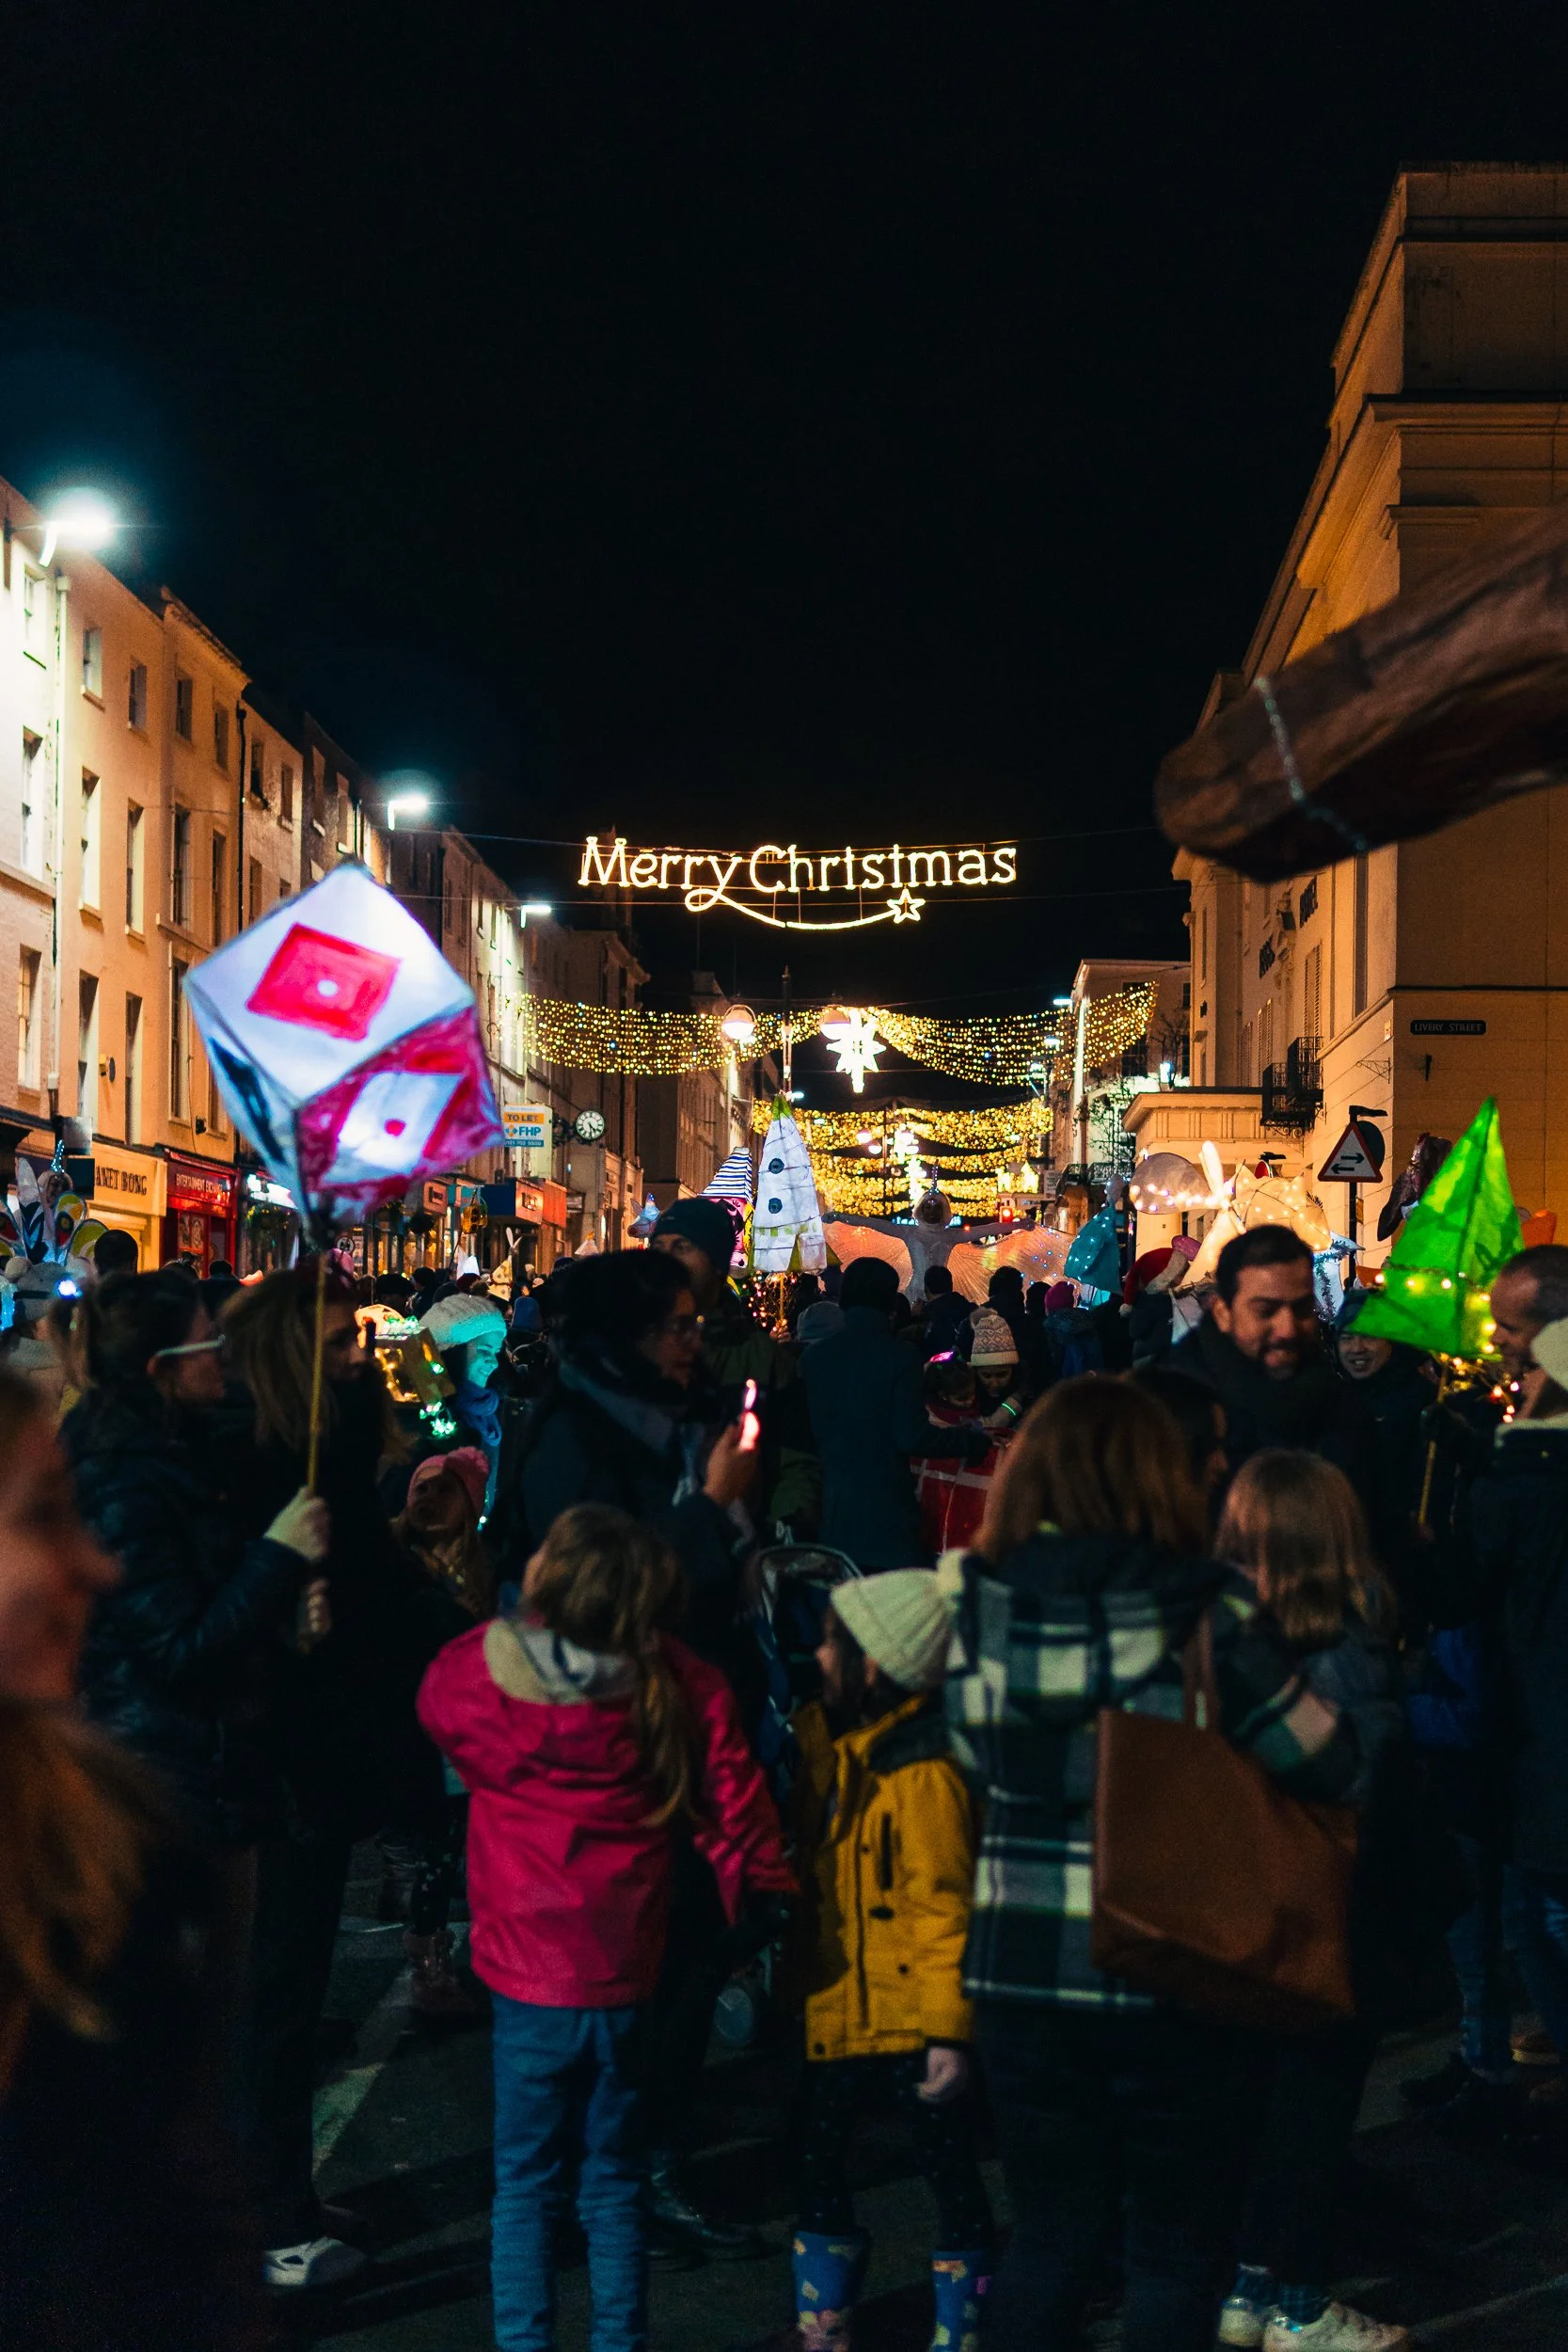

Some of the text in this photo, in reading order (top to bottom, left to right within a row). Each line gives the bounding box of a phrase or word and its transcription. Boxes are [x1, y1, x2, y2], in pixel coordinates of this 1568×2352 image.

[578, 835, 1017, 913] Merry Christmas
[1415, 1023, 1483, 1032] LIVERY STREET
[508, 1114, 539, 1122] TO LET
[519, 1126, 542, 1136] FHP
[95, 1166, 148, 1196] ANET BONG
